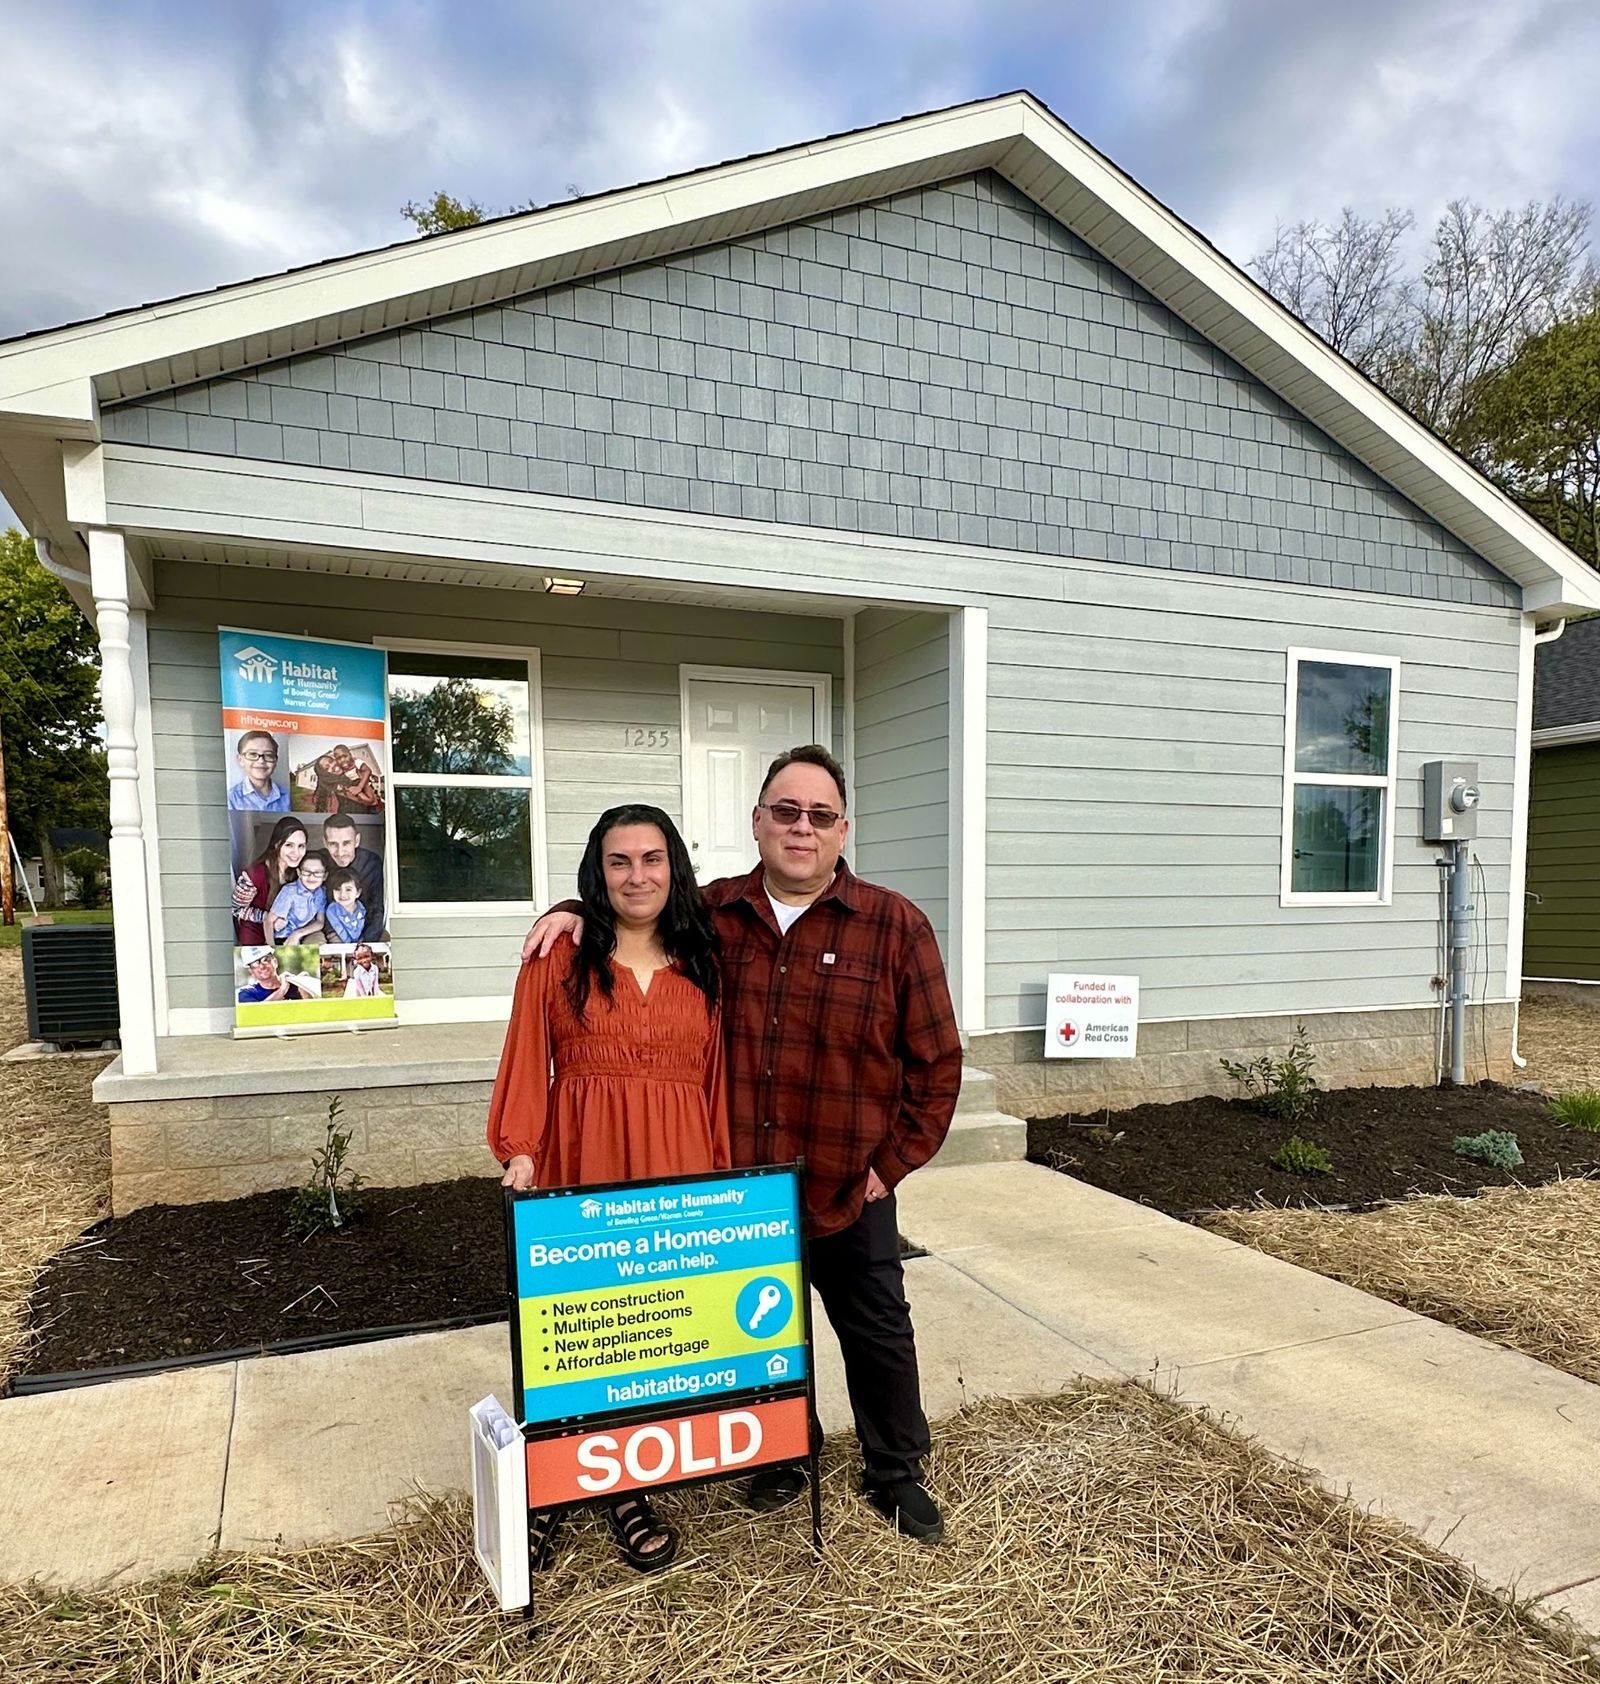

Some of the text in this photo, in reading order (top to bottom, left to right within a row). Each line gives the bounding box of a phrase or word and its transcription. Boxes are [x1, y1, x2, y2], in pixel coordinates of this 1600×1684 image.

[281, 660, 338, 681] Habitat
[282, 676, 338, 692] for Humanity
[283, 687, 290, 695] of
[291, 688, 317, 700] Bowling
[307, 699, 330, 710] County
[624, 728, 669, 748] 1255
[1073, 981, 1116, 992] Funded in
[1055, 994, 1132, 1005] collaboration with
[1084, 1033, 1129, 1043] Red Cross
[1085, 1023, 1129, 1032] American
[605, 1188, 745, 1217] Habitat for Humanity
[529, 1218, 795, 1267] Become a Homeowner.
[617, 1251, 719, 1278] We can help.
[552, 1288, 685, 1318] New construction
[553, 1306, 693, 1336] Multiple bedrooms
[554, 1325, 673, 1354] New appliances
[555, 1338, 710, 1373] Affordable mortgage
[606, 1367, 737, 1404] habitatbg.org
[575, 1411, 764, 1493] SOLD
